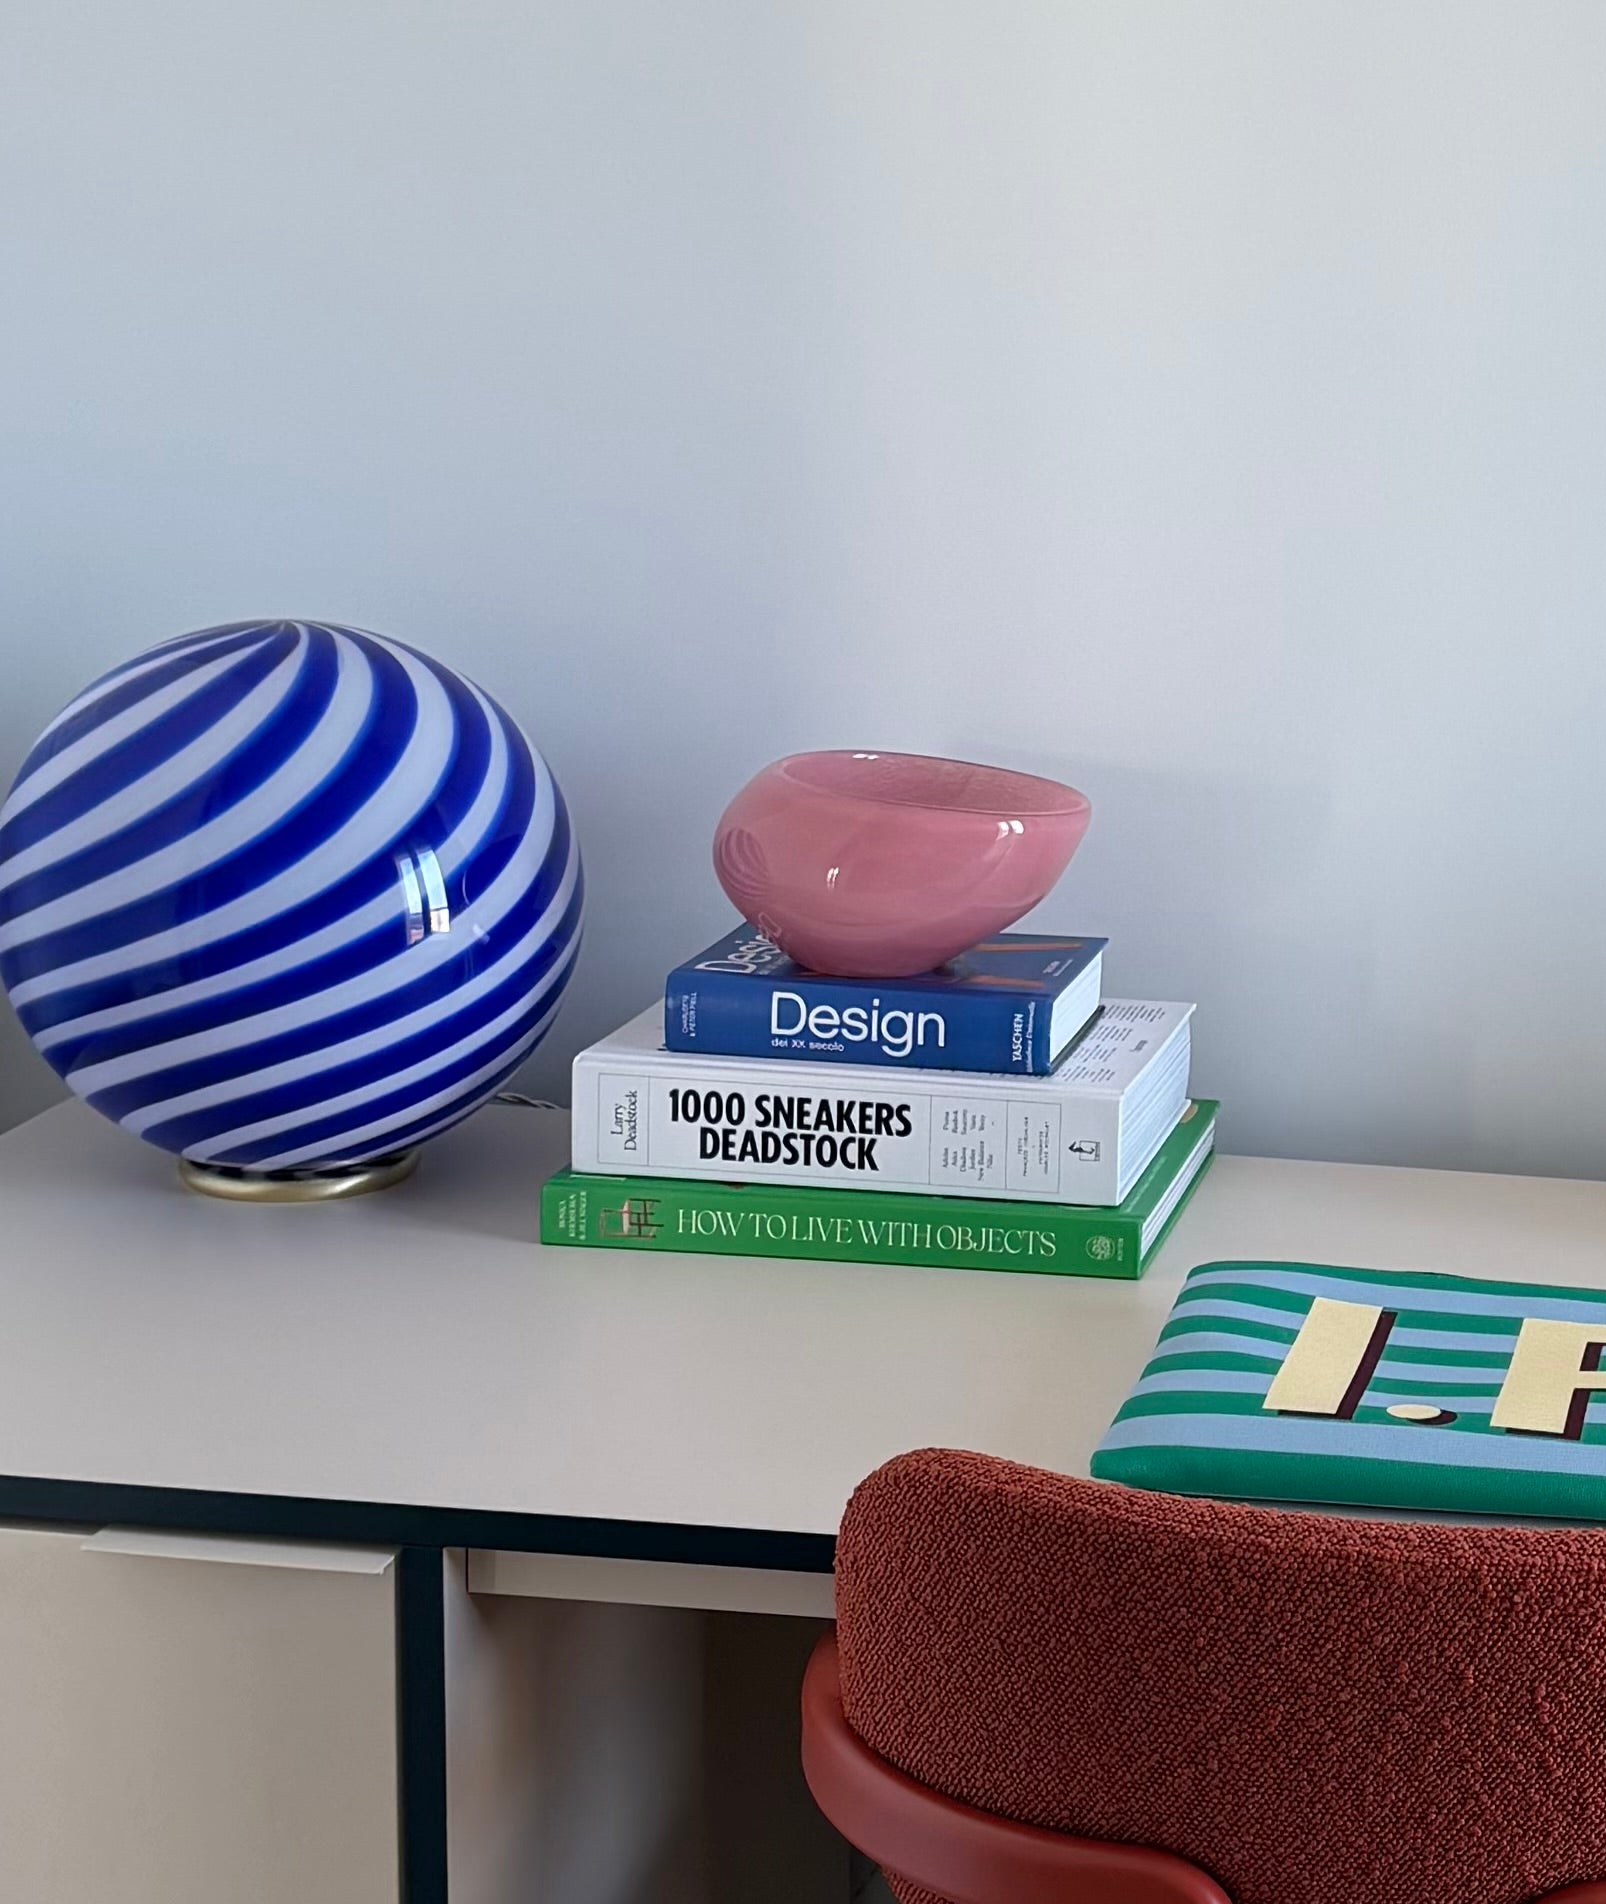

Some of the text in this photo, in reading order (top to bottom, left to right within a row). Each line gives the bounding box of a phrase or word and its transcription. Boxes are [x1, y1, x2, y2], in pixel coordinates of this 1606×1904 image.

[771, 991, 945, 1057] Design
[791, 1039, 806, 1049] XX
[809, 1041, 845, 1052] secolo
[1012, 1013, 1024, 1062] TASCHEN
[610, 1103, 627, 1135] Larry
[624, 1090, 637, 1151] Deadstock
[669, 1088, 913, 1138] 1000 SNEAKERS
[700, 1126, 879, 1171] DEADSTOCK
[677, 1208, 1057, 1257] HOW TO LIVE WITH OBJECTS
